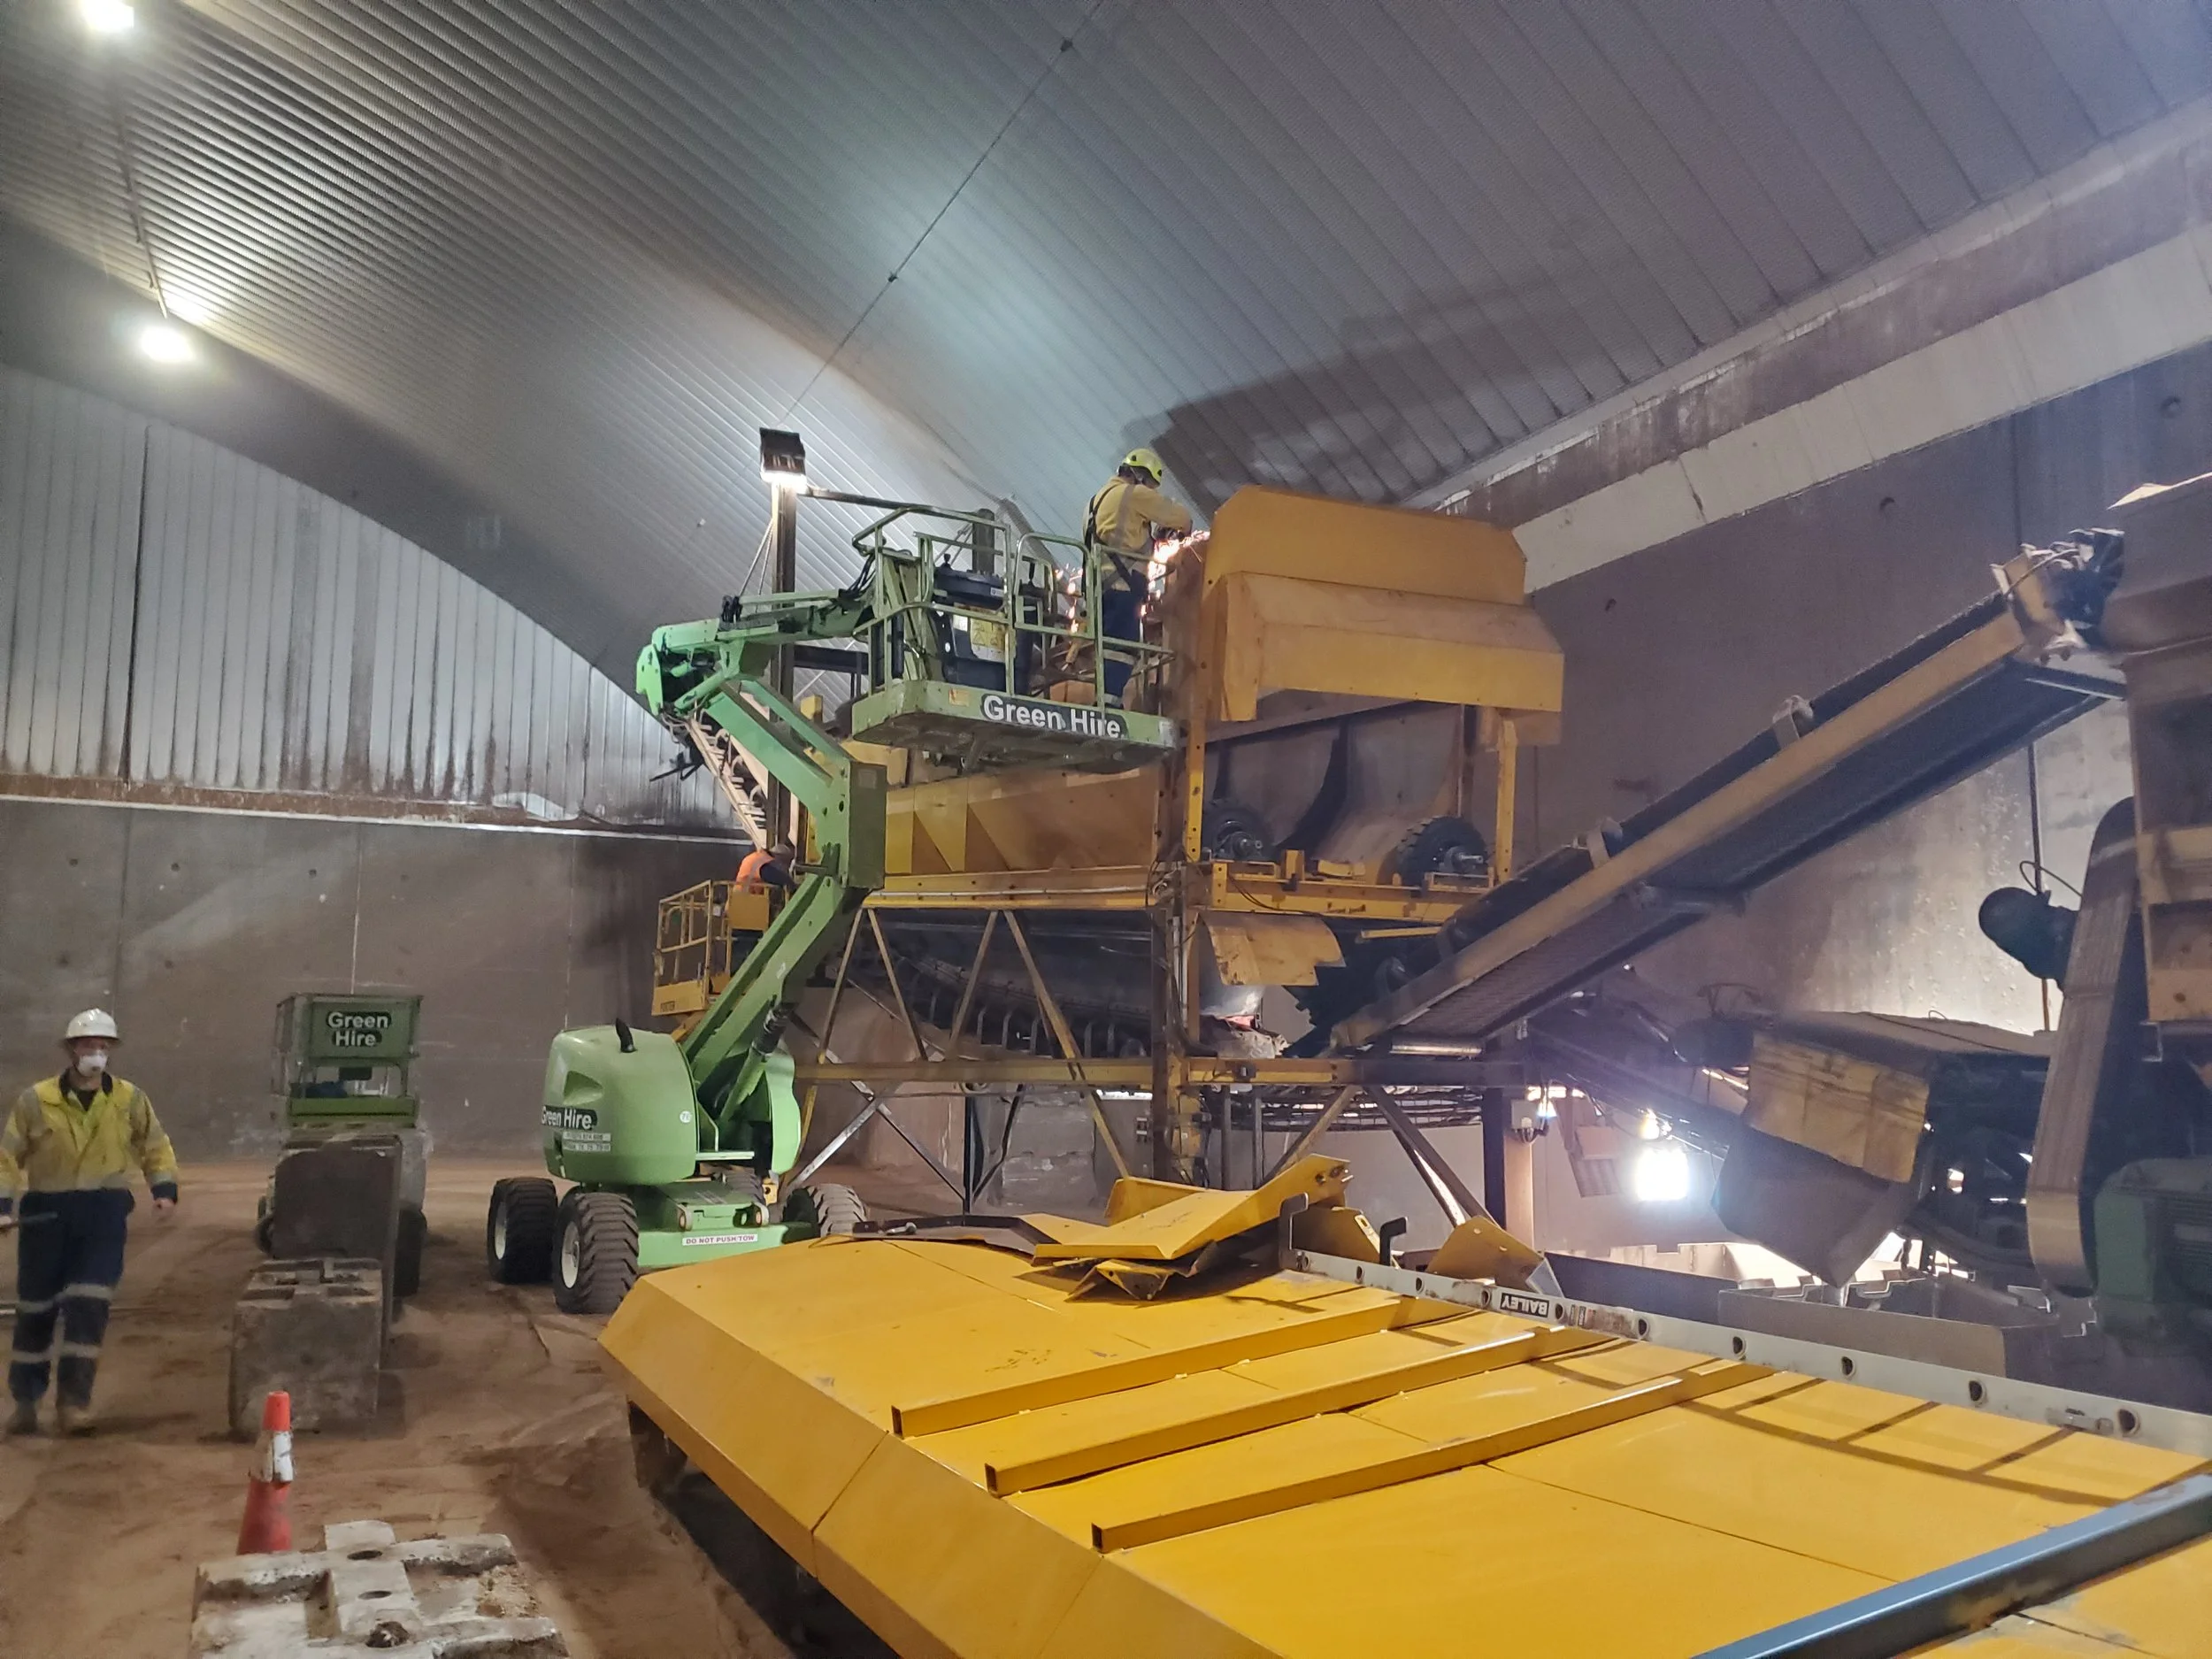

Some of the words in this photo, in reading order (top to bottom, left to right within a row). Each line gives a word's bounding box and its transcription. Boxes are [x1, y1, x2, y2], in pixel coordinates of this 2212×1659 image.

[983, 695, 1063, 730] Green
[328, 1011, 388, 1028] Green
[336, 1030, 376, 1046] Hire
[541, 1105, 562, 1126] Green
[564, 1109, 593, 1130] Hire
[1502, 1294, 1548, 1316] BAILEY
